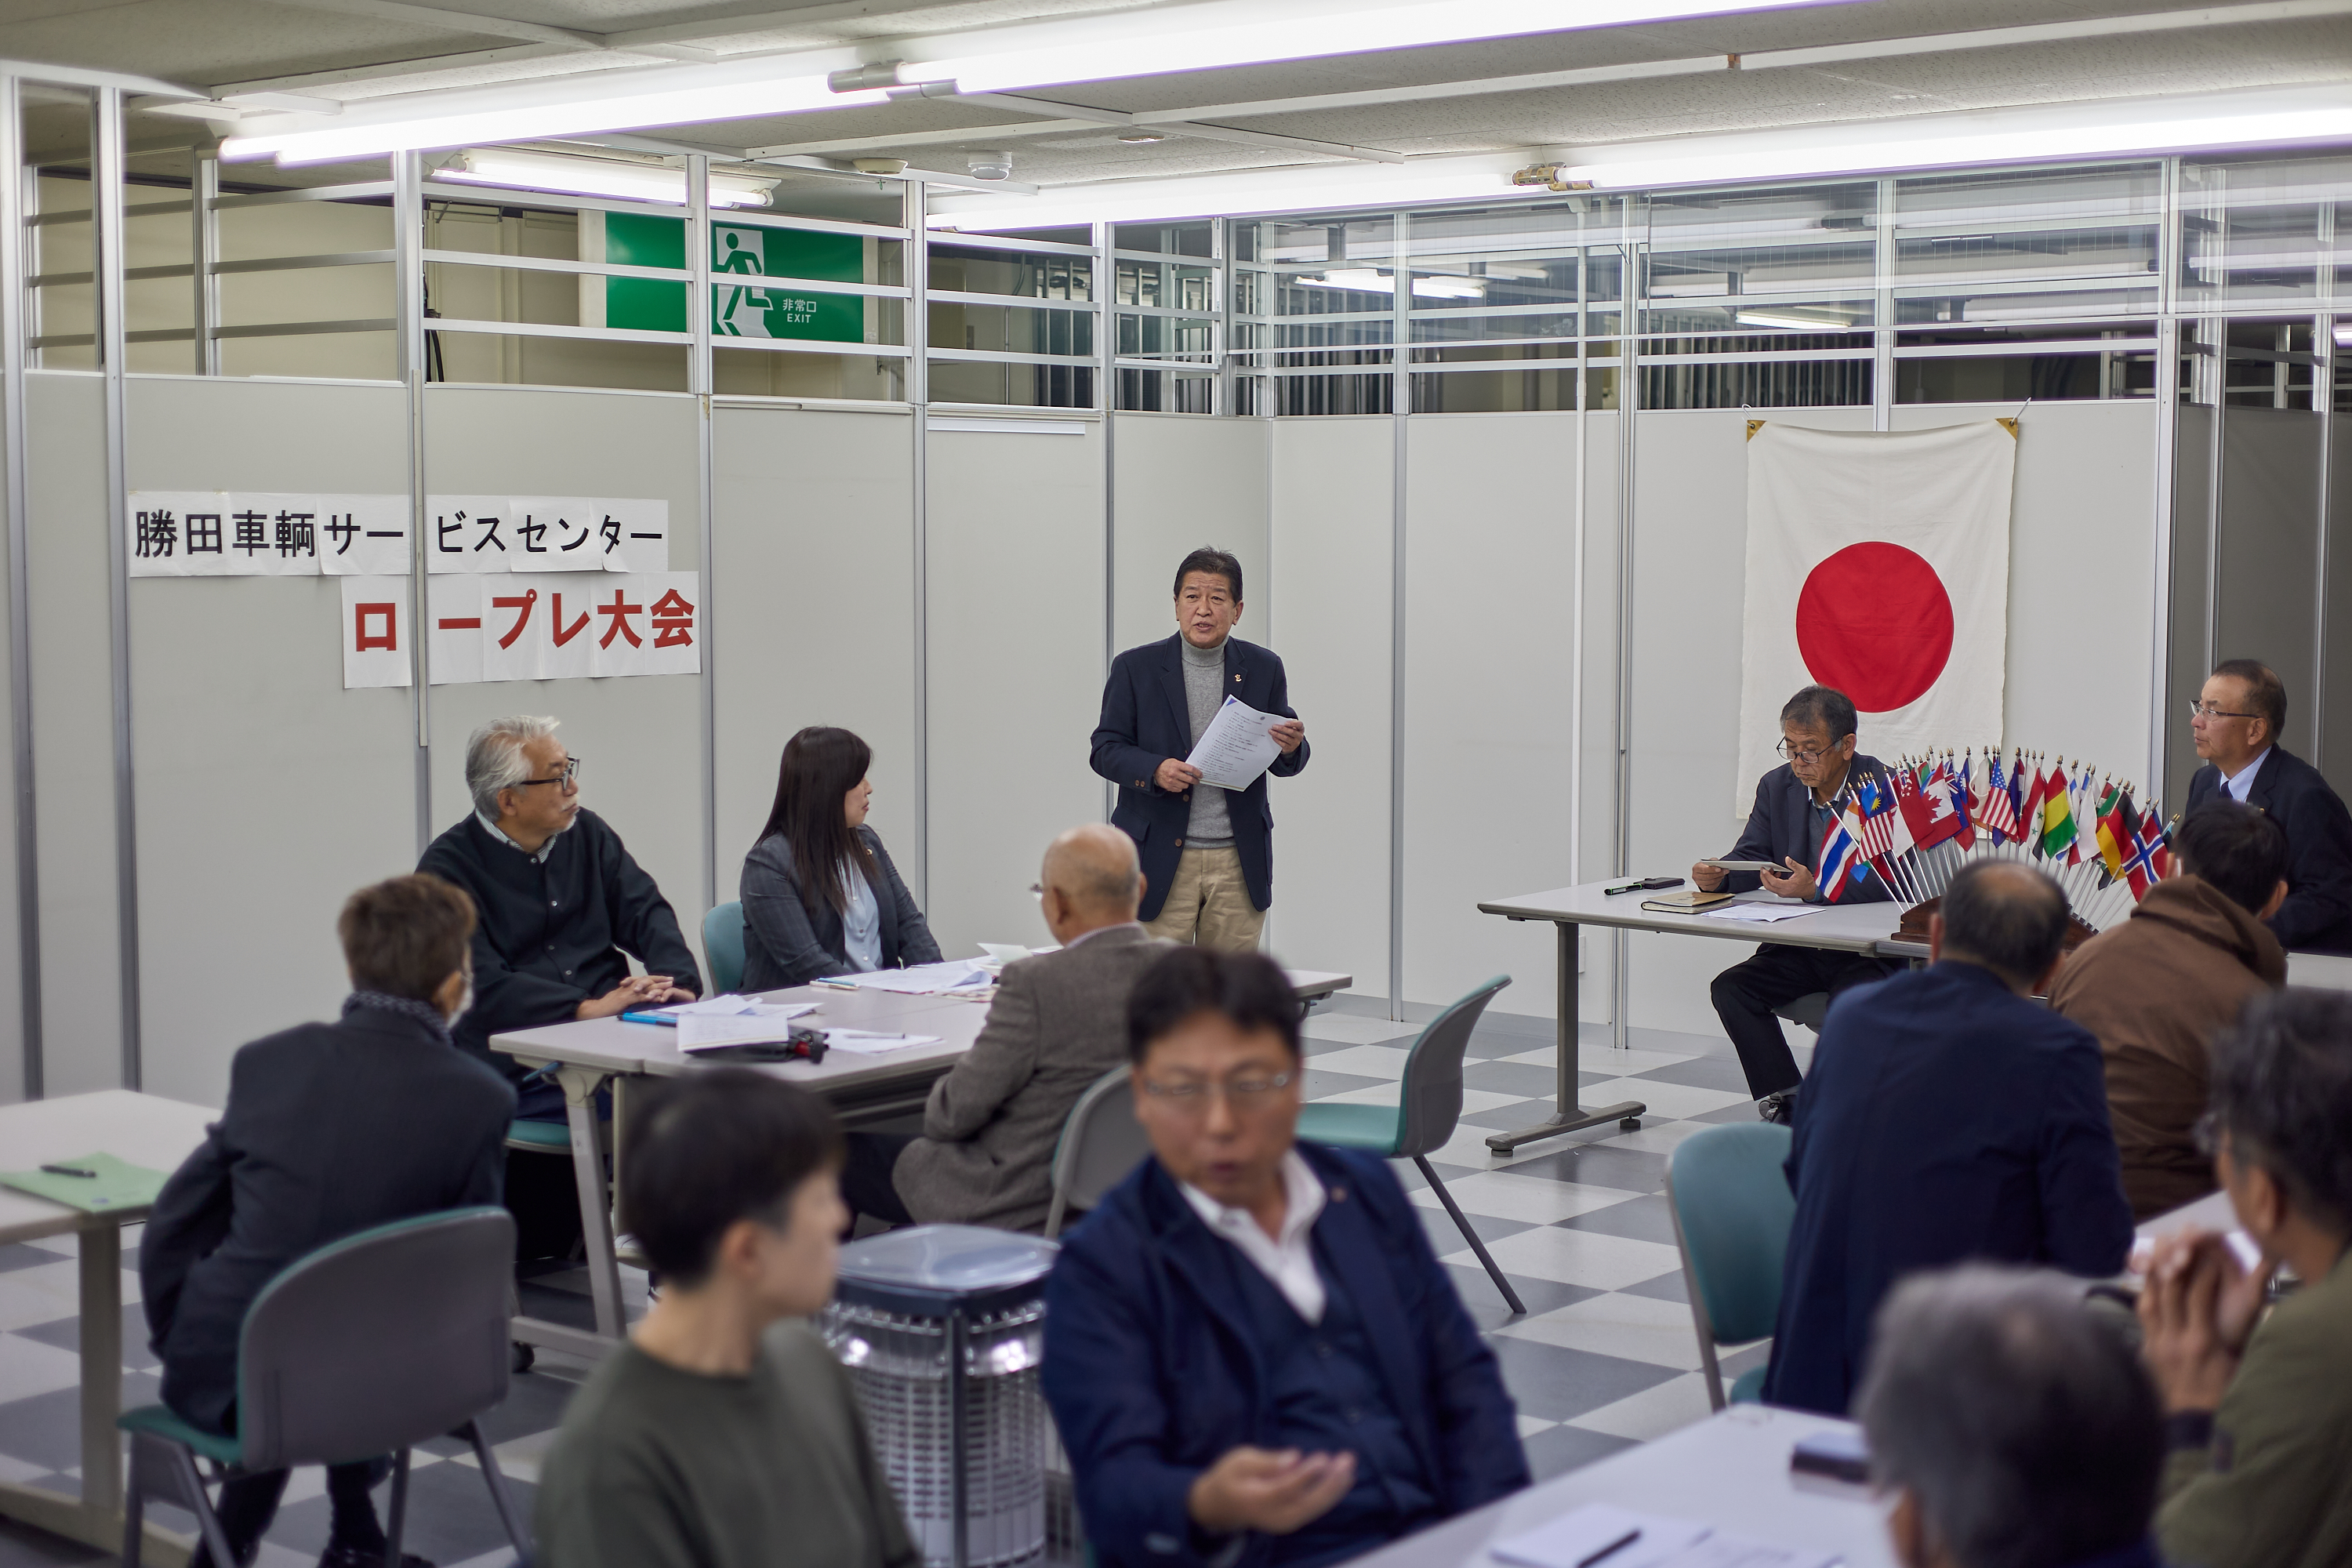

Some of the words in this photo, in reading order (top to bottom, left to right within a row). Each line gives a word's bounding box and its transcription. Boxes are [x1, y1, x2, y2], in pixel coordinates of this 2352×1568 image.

[782, 298, 817, 313] 非常口
[786, 313, 811, 323] EXIT
